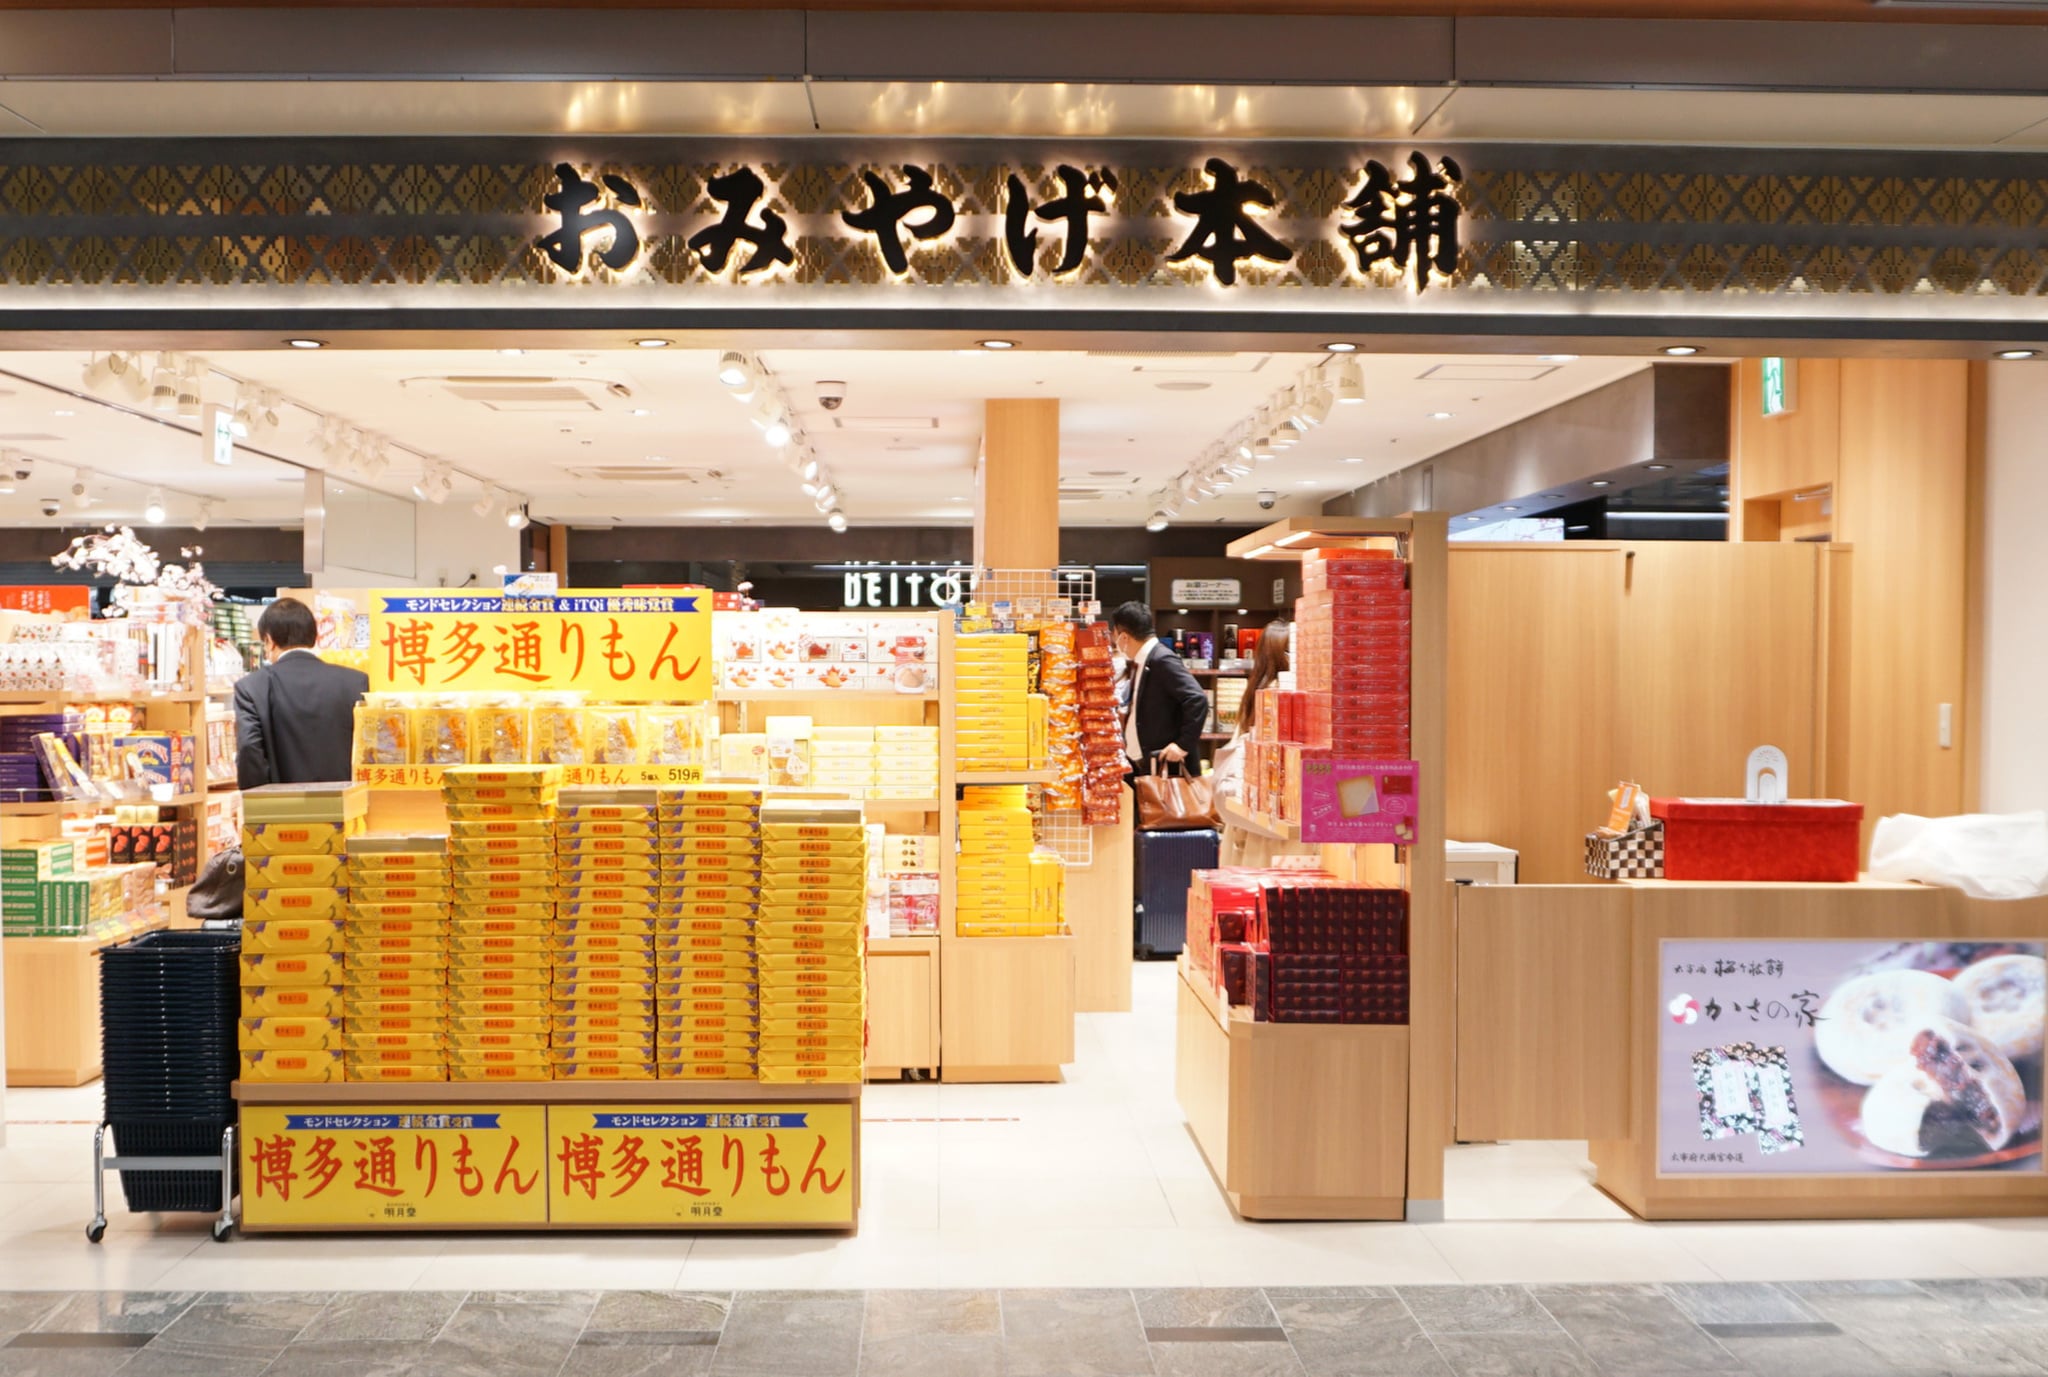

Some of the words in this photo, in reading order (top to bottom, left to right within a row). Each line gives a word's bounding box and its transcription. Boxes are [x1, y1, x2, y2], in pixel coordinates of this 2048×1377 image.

[536, 150, 1463, 294] おみやげ本舗
[559, 601, 570, 612] &
[381, 617, 701, 685] 博多通りもん
[668, 768, 700, 781] 519円
[303, 1117, 391, 1128] モンドセレクション
[611, 1115, 699, 1127] モンドセレクション
[249, 1133, 539, 1202] 博多通りもん
[556, 1132, 846, 1200] 博多通りもん
